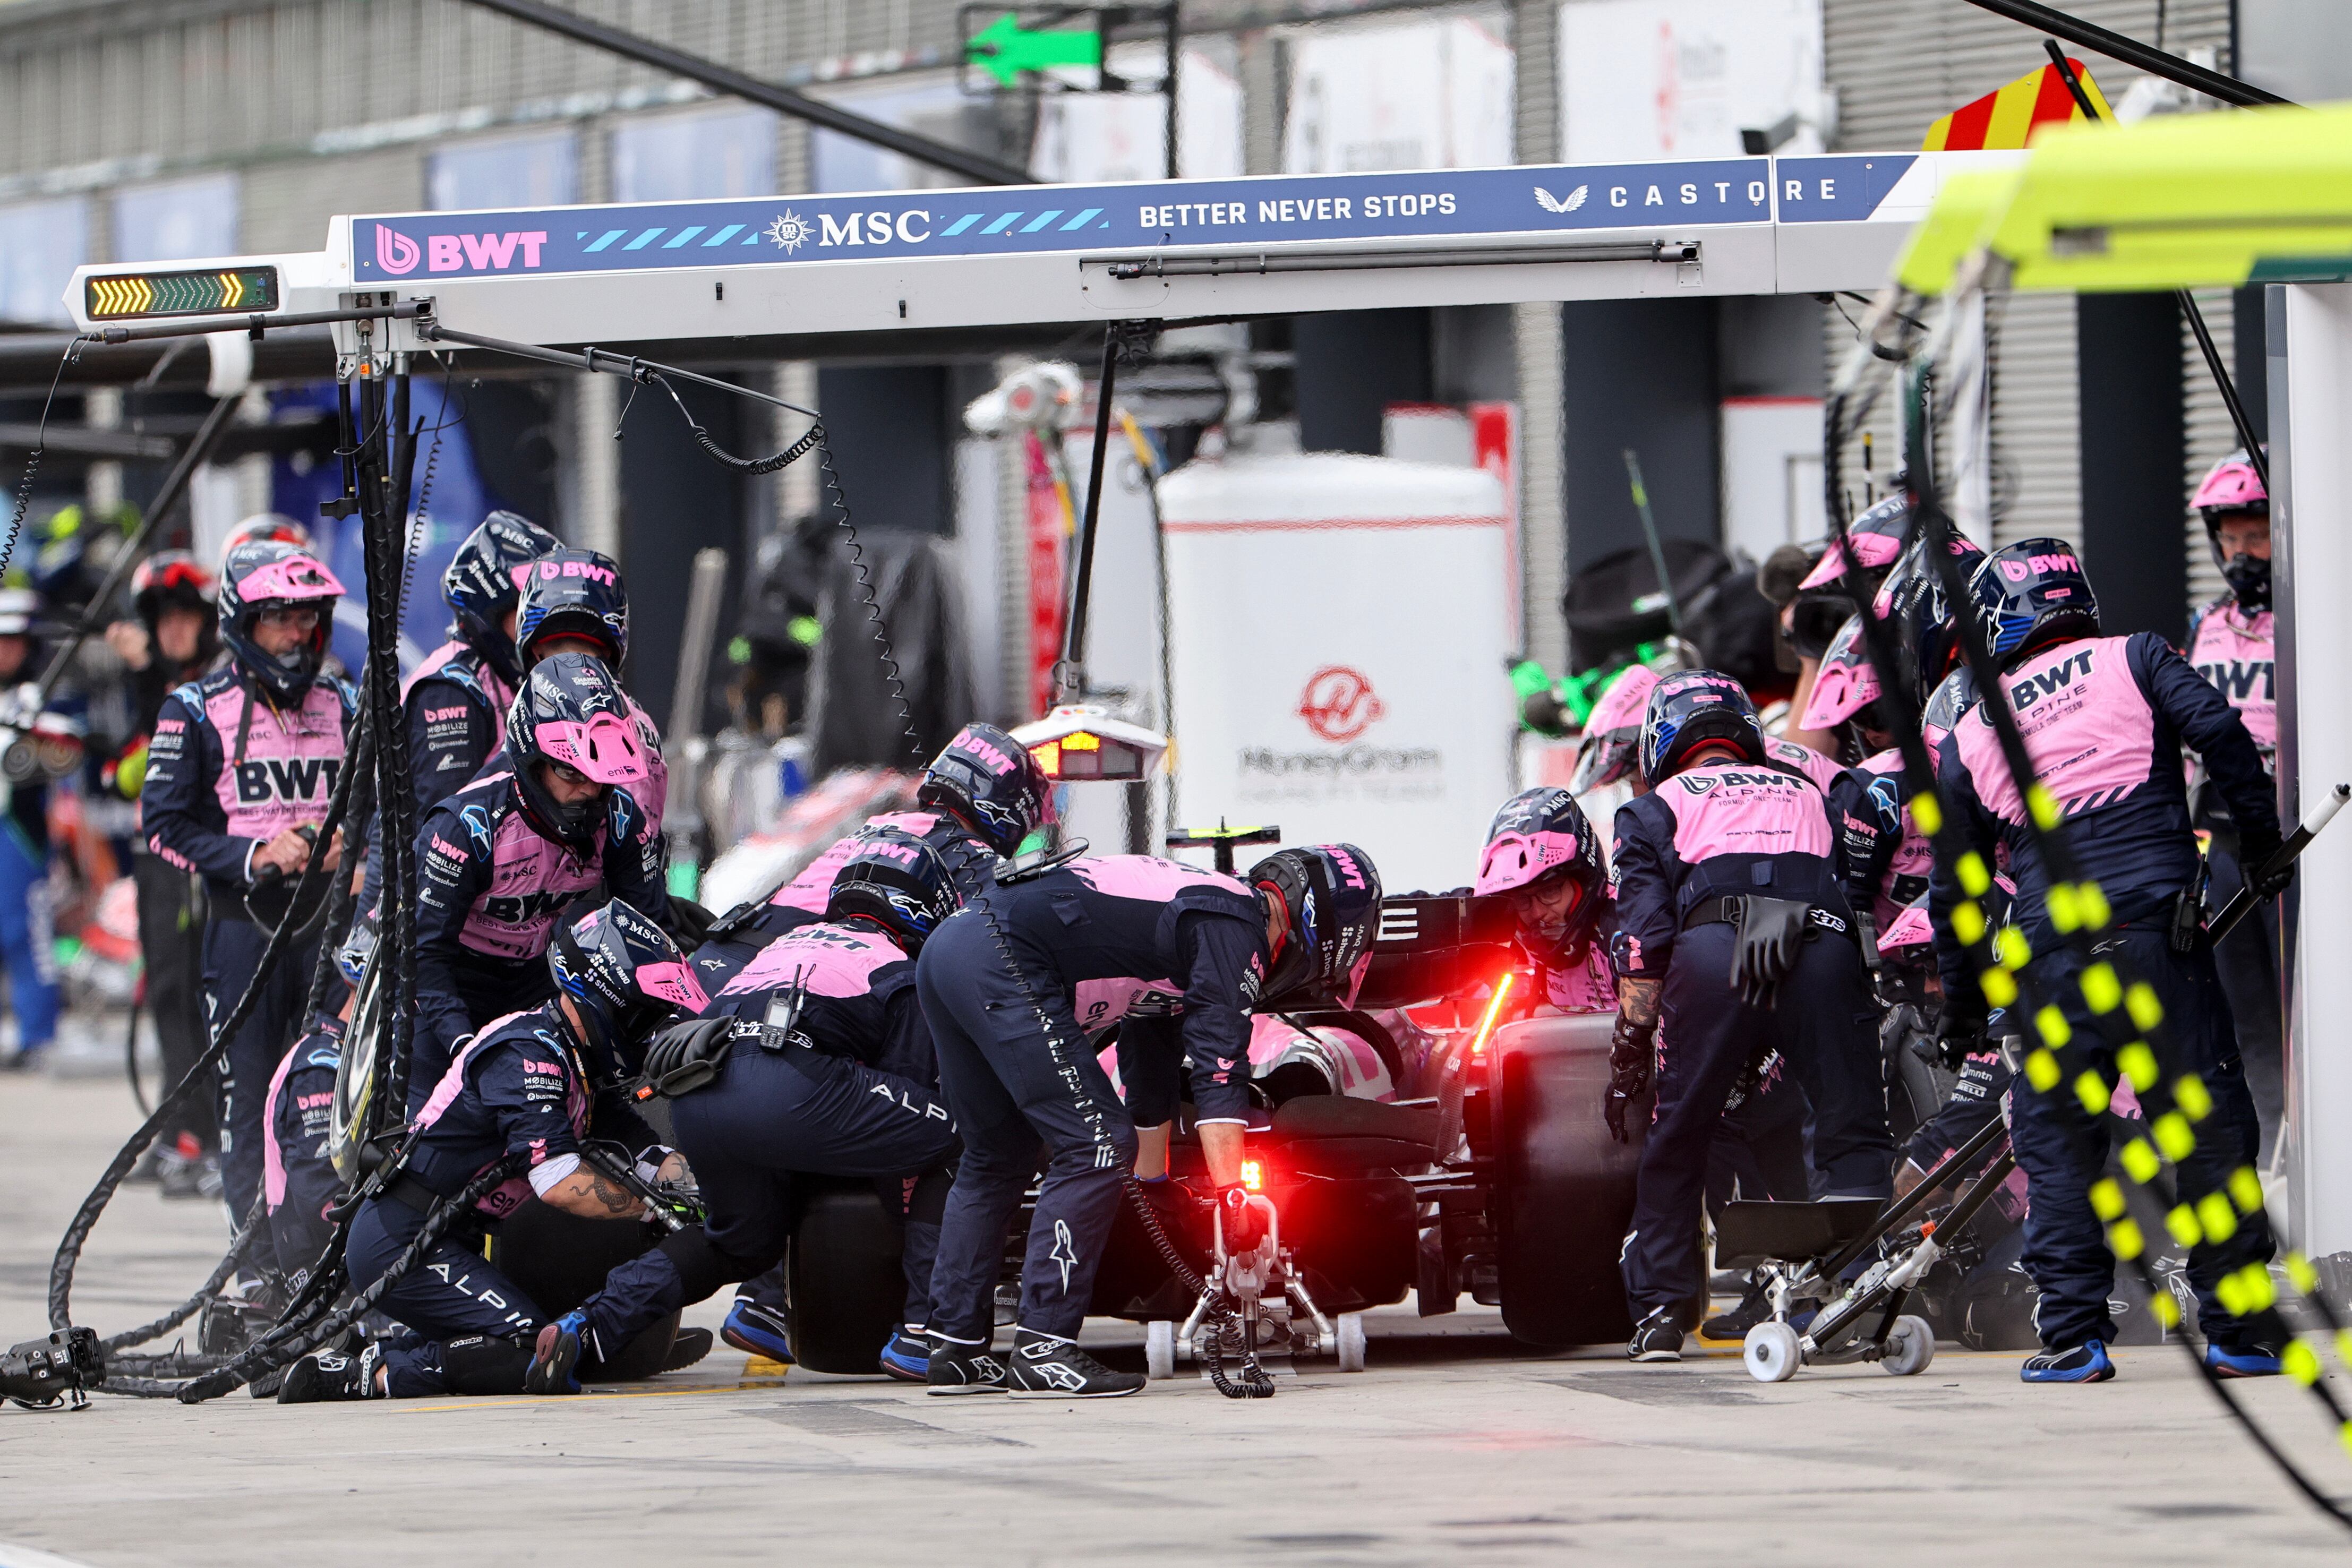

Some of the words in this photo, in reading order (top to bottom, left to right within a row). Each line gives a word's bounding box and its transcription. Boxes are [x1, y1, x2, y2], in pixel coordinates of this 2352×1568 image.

[1610, 178, 1836, 208] CASTORE
[1140, 203, 1233, 228] BETTER
[1258, 198, 1353, 224] NEVER
[1363, 193, 1457, 219] STOPS
[818, 210, 931, 247] MSC
[429, 231, 548, 272] BWT
[501, 528, 534, 549] MSC
[562, 561, 615, 587] BWT
[2026, 554, 2079, 576] BWT
[541, 679, 568, 704] MSC
[1687, 676, 1741, 693] BWT
[2009, 648, 2093, 712] BWT
[1949, 686, 1965, 714] MSC
[2017, 683, 2087, 728] LPINE
[437, 705, 468, 722] BWT
[512, 722, 527, 755] shamir
[570, 743, 580, 758] BWT
[964, 736, 1016, 777] BWT
[608, 767, 623, 777] eni
[1718, 773, 1805, 792] BWT
[1546, 792, 1573, 811] MSC
[1847, 817, 1878, 838] BWT
[437, 840, 469, 864] BWT
[864, 842, 920, 866] BWT
[1327, 848, 1366, 890] BWT
[476, 916, 499, 929] BEST
[629, 920, 661, 945] MSC
[594, 978, 627, 1008] shamir
[679, 983, 692, 1000] BWT
[1968, 1068, 1994, 1083] mntn
